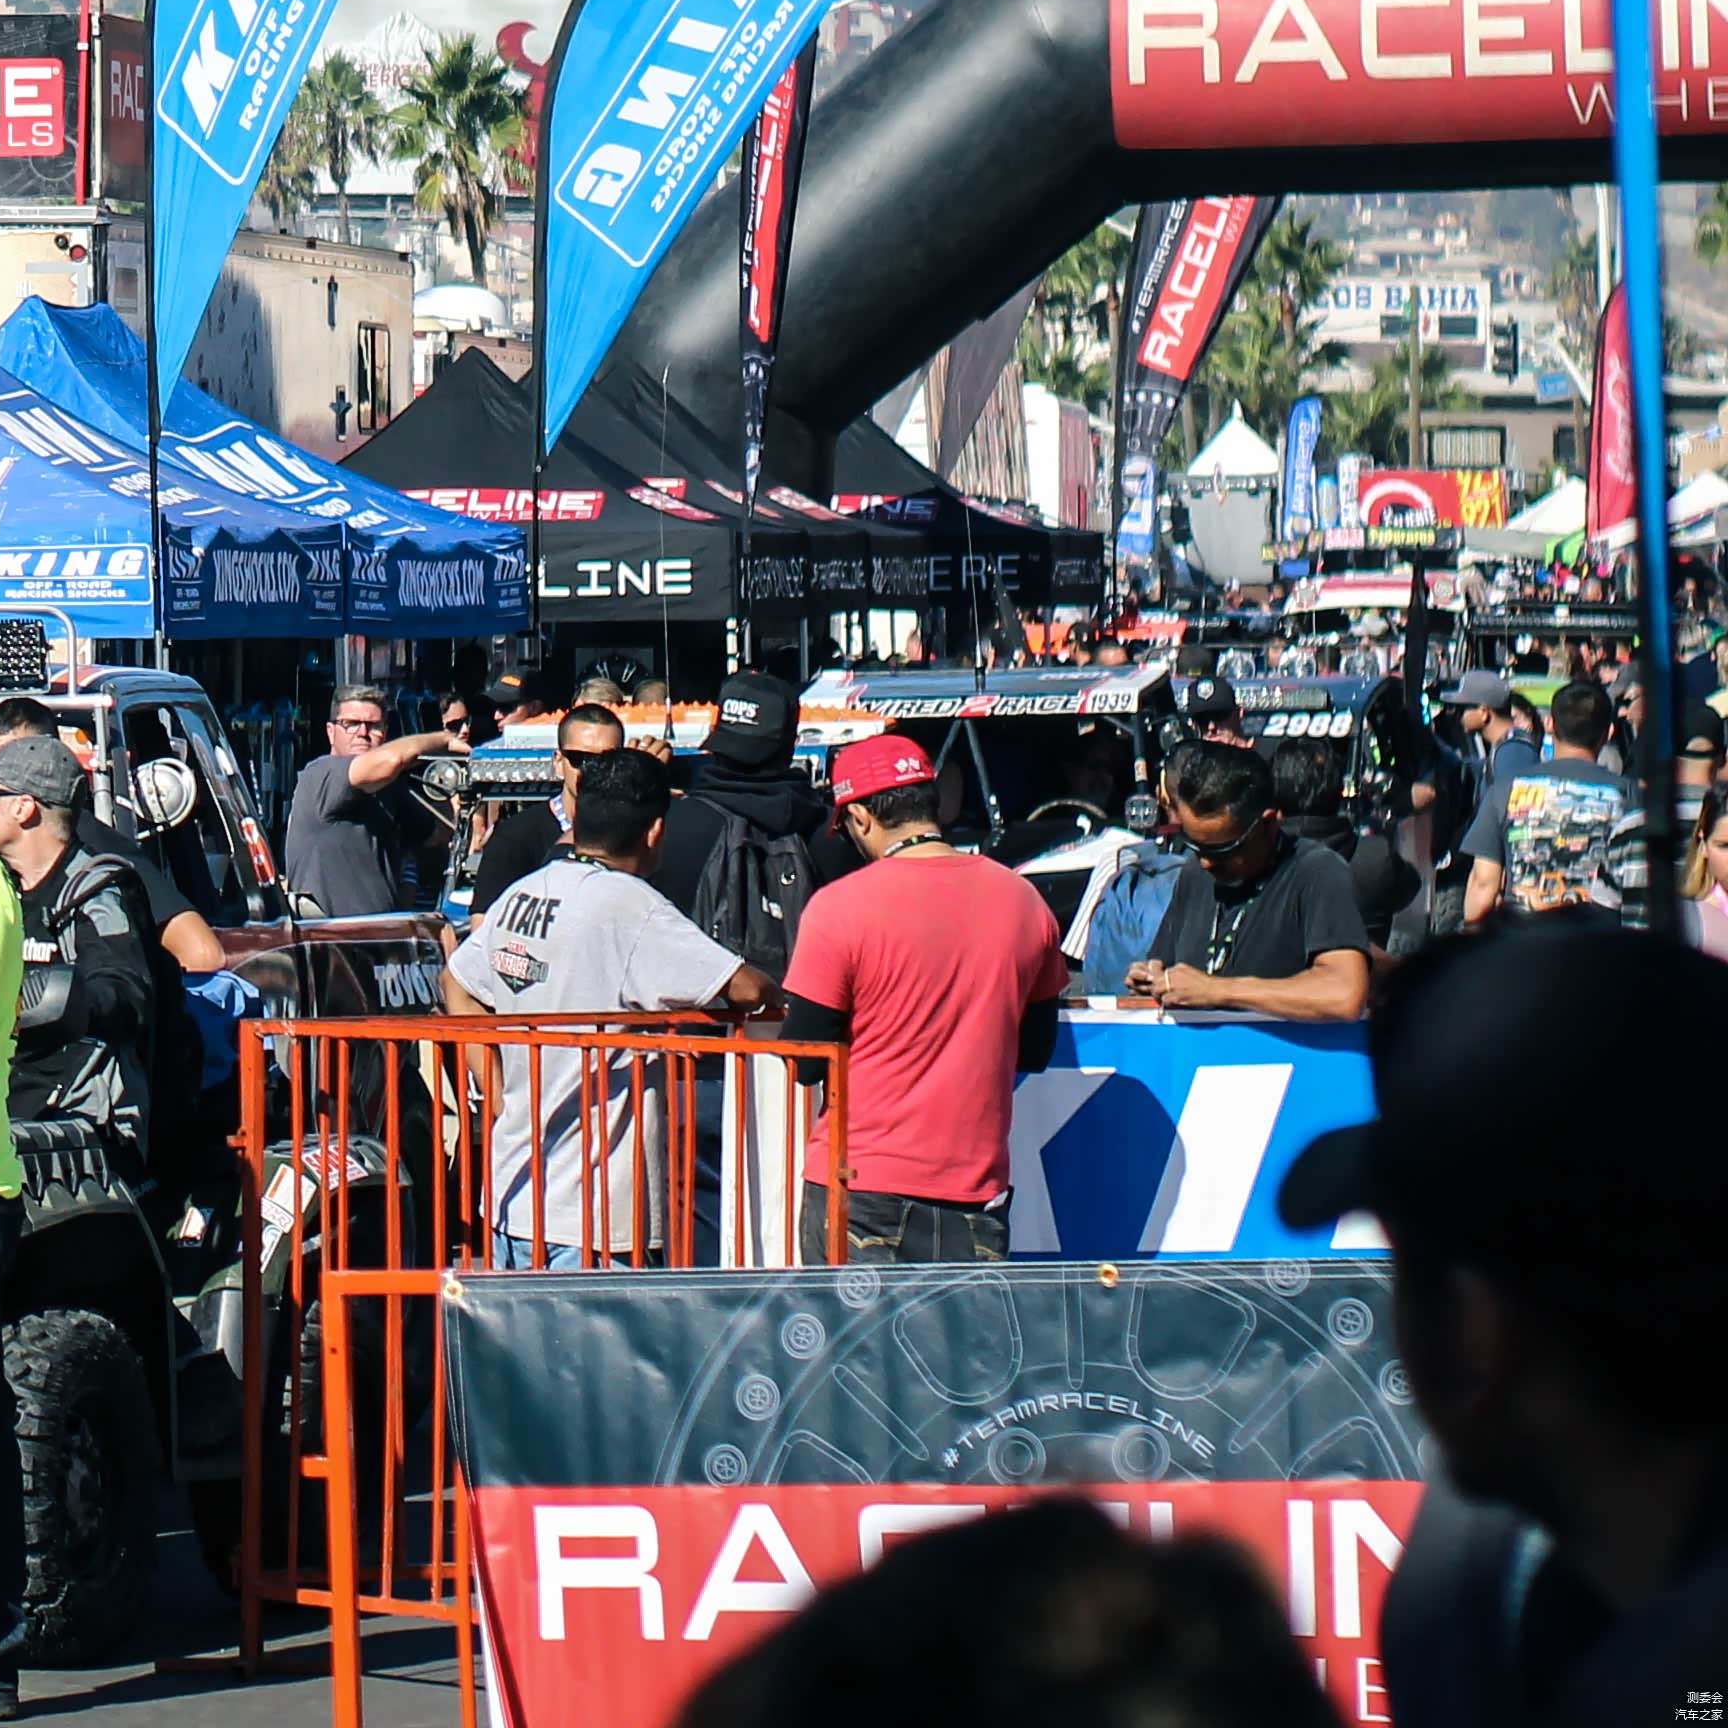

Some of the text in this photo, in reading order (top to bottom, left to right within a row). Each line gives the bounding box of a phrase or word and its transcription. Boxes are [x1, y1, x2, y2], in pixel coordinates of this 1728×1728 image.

[111, 60, 144, 121] RAC
[1131, 197, 1188, 334] #TEAMRACE
[1144, 194, 1234, 371] RACELI
[4, 589, 127, 599] RACING SHOCKS
[68, 580, 113, 589] ROAD
[723, 698, 759, 719] COPS
[1094, 692, 1134, 712] 1939
[496, 889, 562, 940] STAFF
[23, 937, 59, 962] thor
[373, 965, 444, 1009] TOYOT
[943, 1390, 1218, 1469] #TEAMRACELINE
